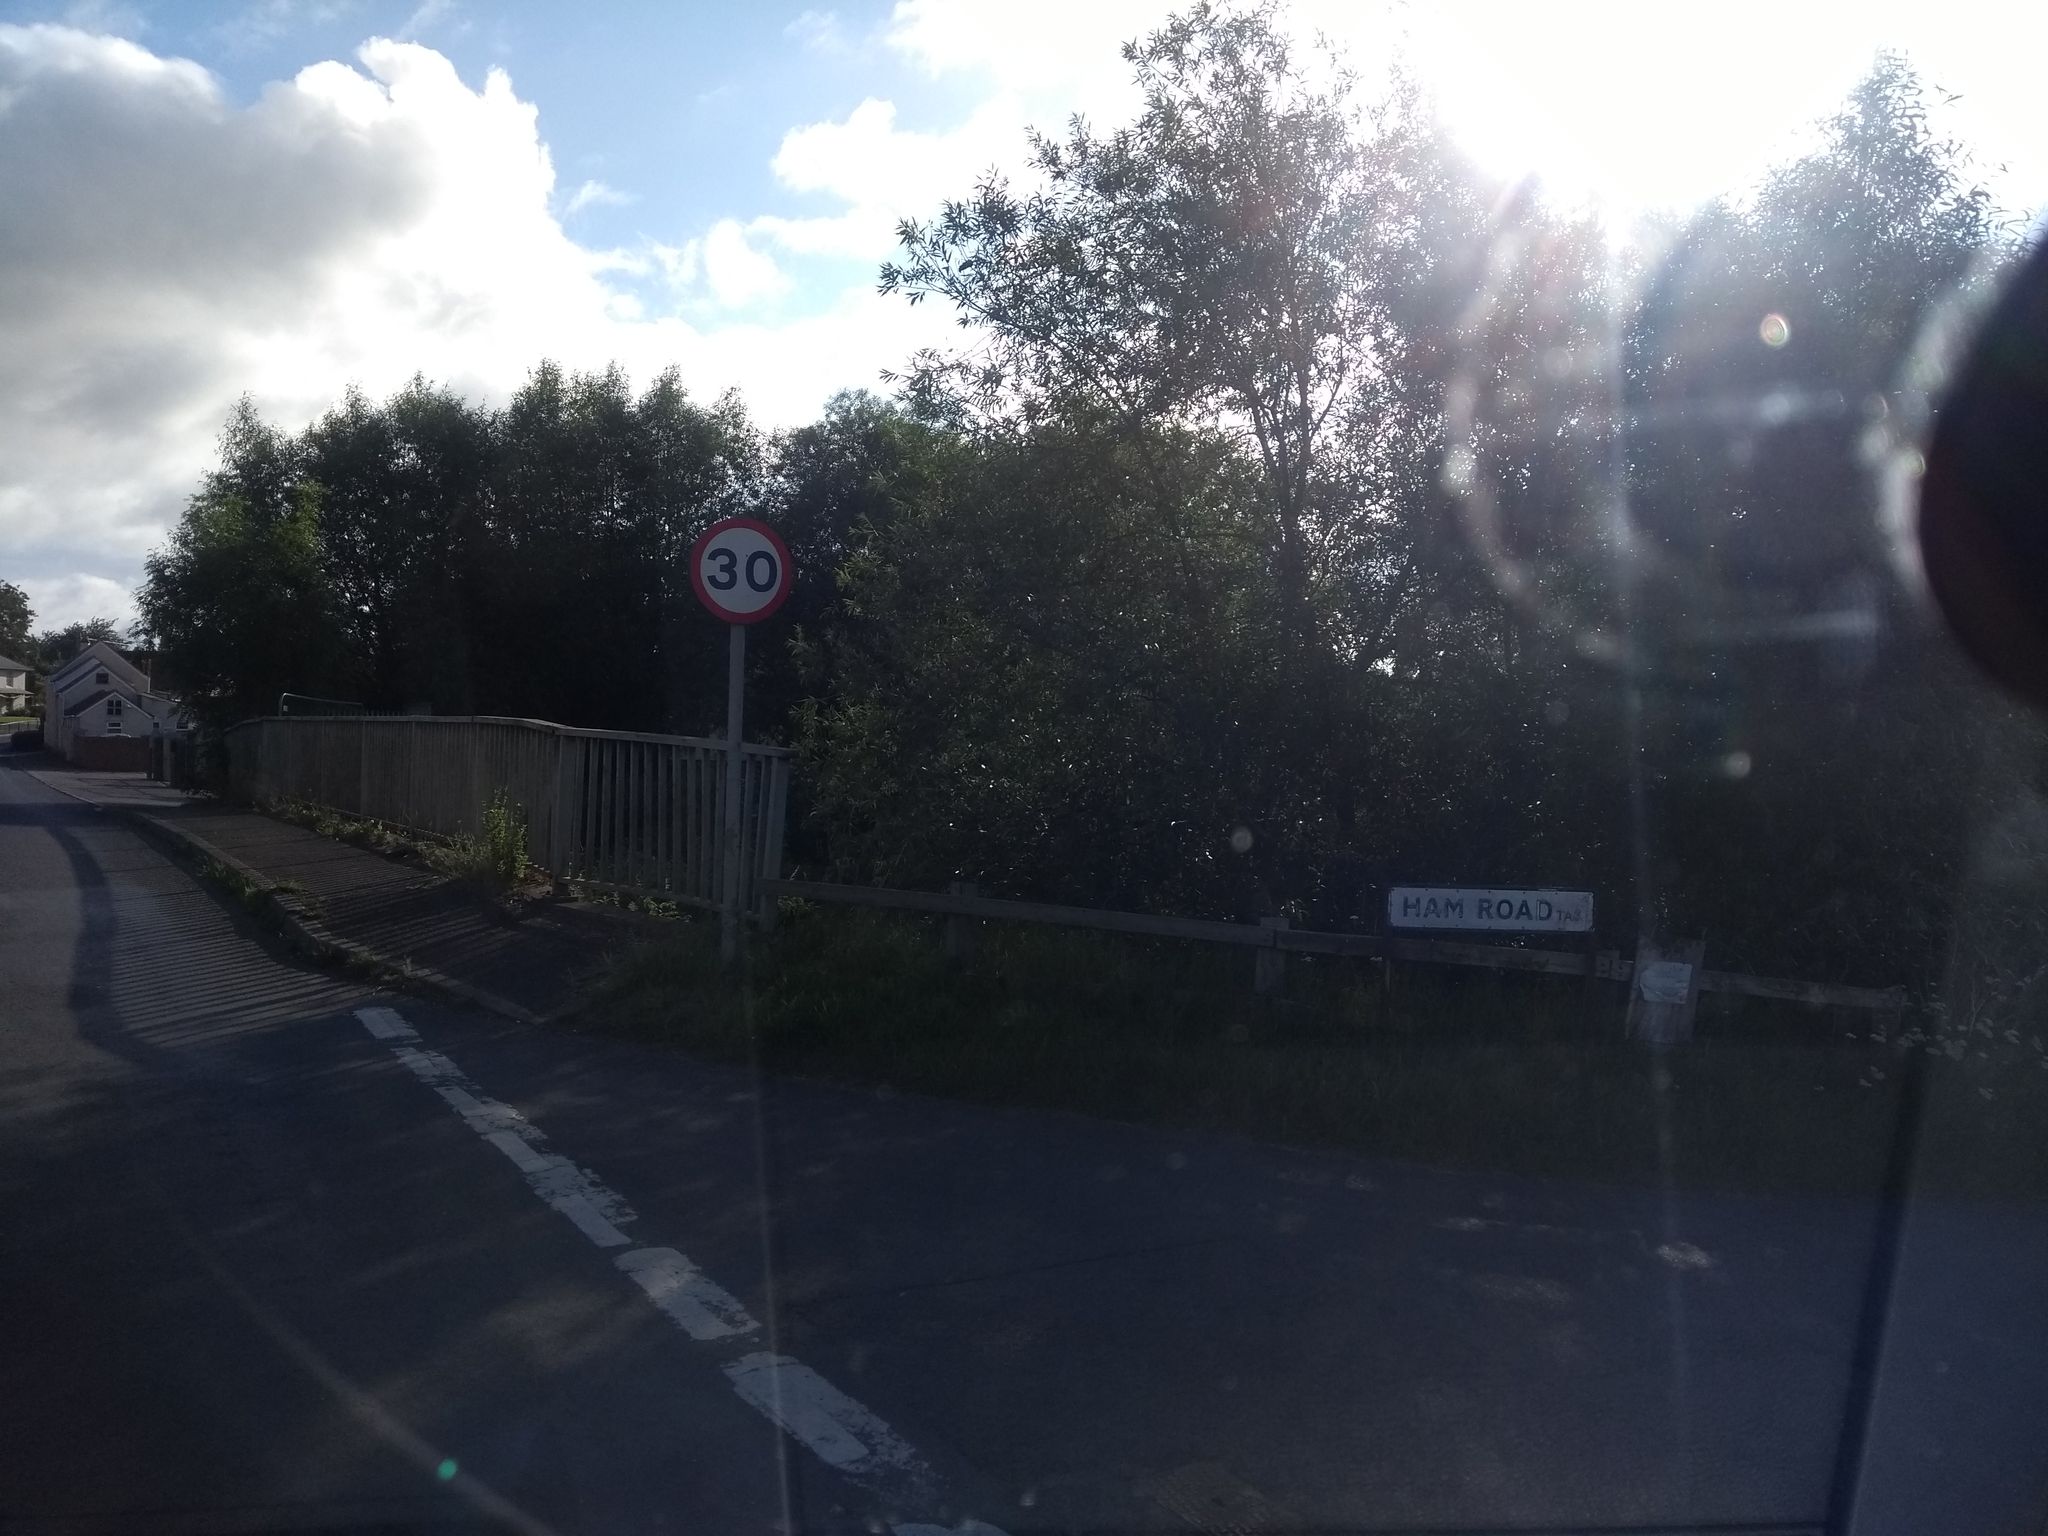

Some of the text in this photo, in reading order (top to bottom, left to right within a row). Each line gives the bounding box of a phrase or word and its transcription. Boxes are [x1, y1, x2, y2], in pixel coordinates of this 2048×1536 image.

[707, 548, 778, 593] 30
[1403, 896, 1464, 919] HAM
[1477, 898, 1553, 922] ROAD
